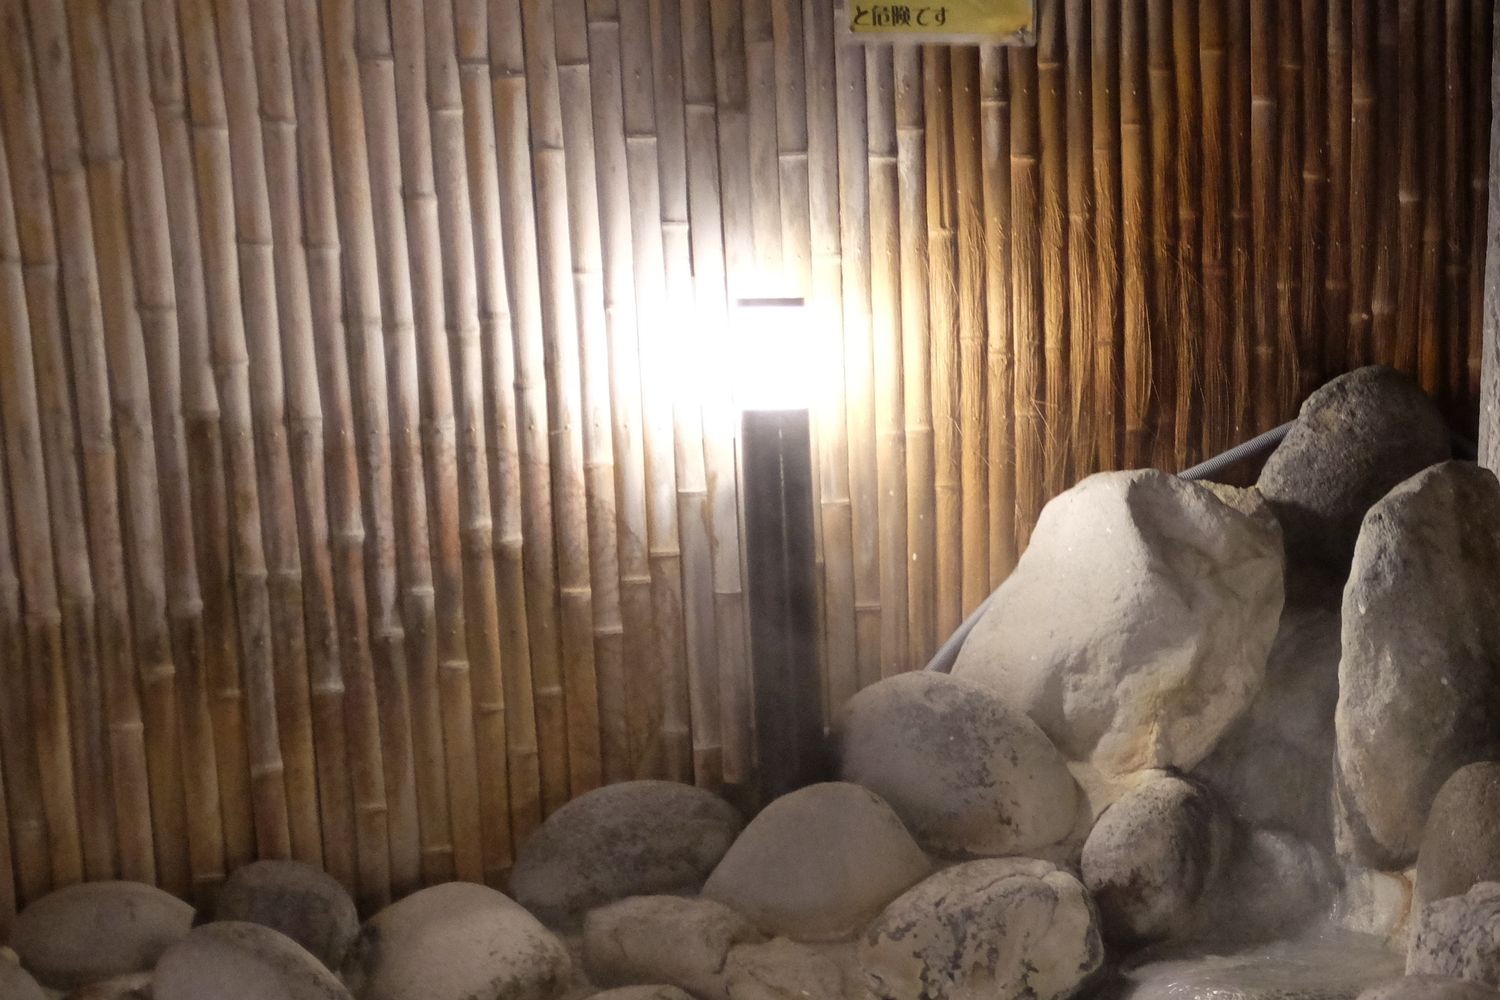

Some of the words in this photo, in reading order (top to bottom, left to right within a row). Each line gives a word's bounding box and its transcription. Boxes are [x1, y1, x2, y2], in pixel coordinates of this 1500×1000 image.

[853, 5, 948, 27] と危険です
